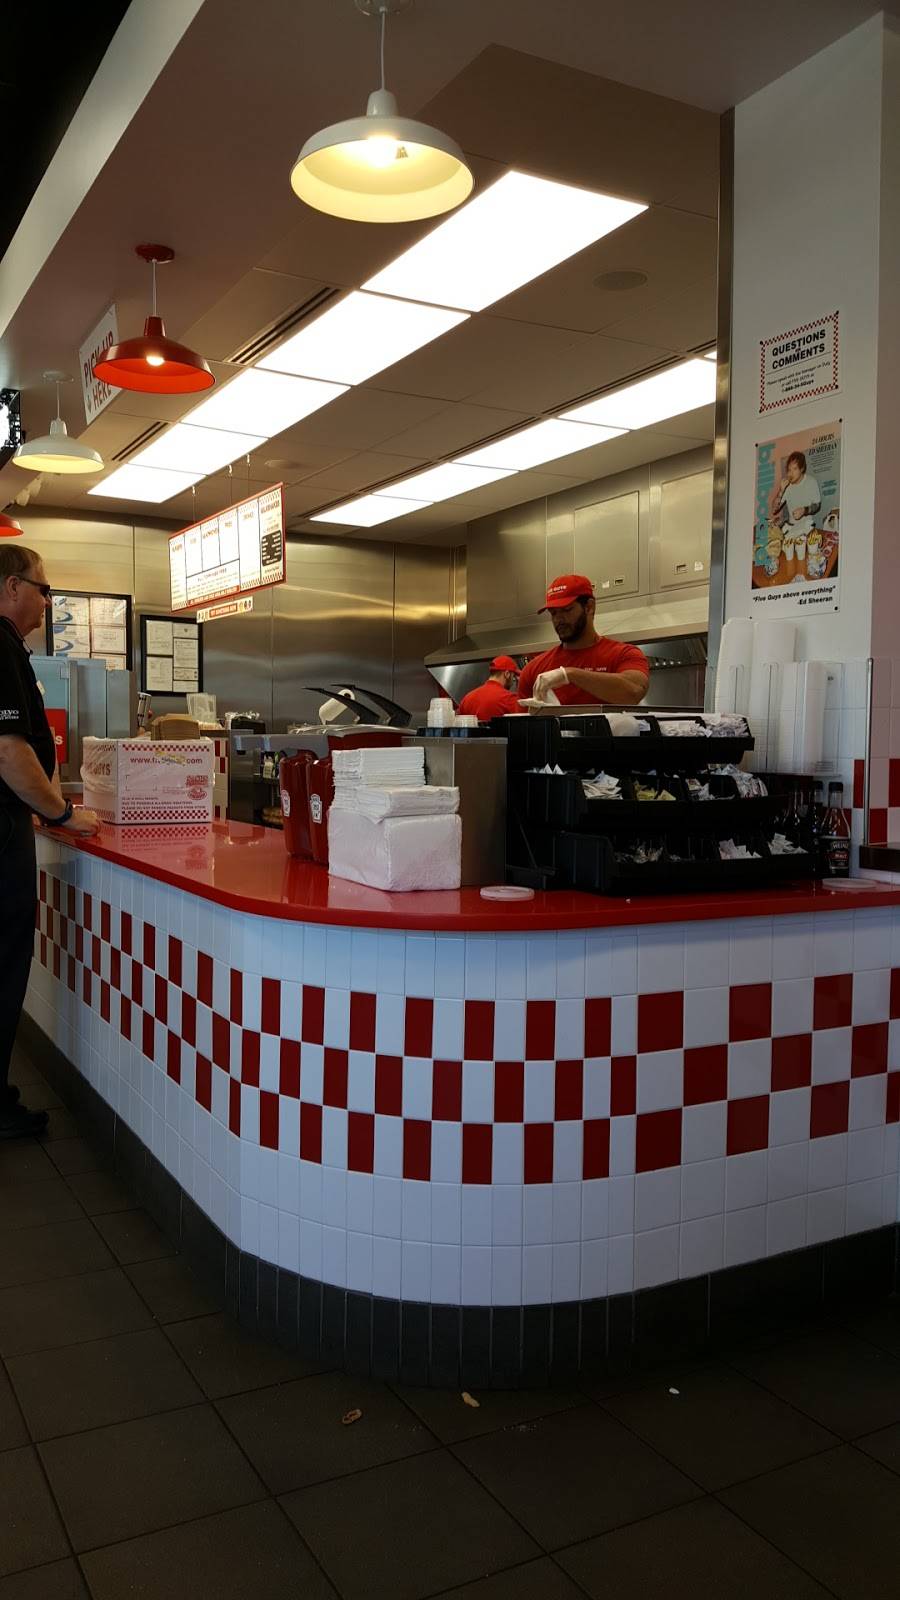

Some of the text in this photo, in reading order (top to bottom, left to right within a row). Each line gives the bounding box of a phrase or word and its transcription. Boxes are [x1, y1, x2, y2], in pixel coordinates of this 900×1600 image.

[772, 329, 826, 357] QUESTIONS
[772, 343, 825, 369] COMMENTS
[808, 596, 833, 604] Sheeran
